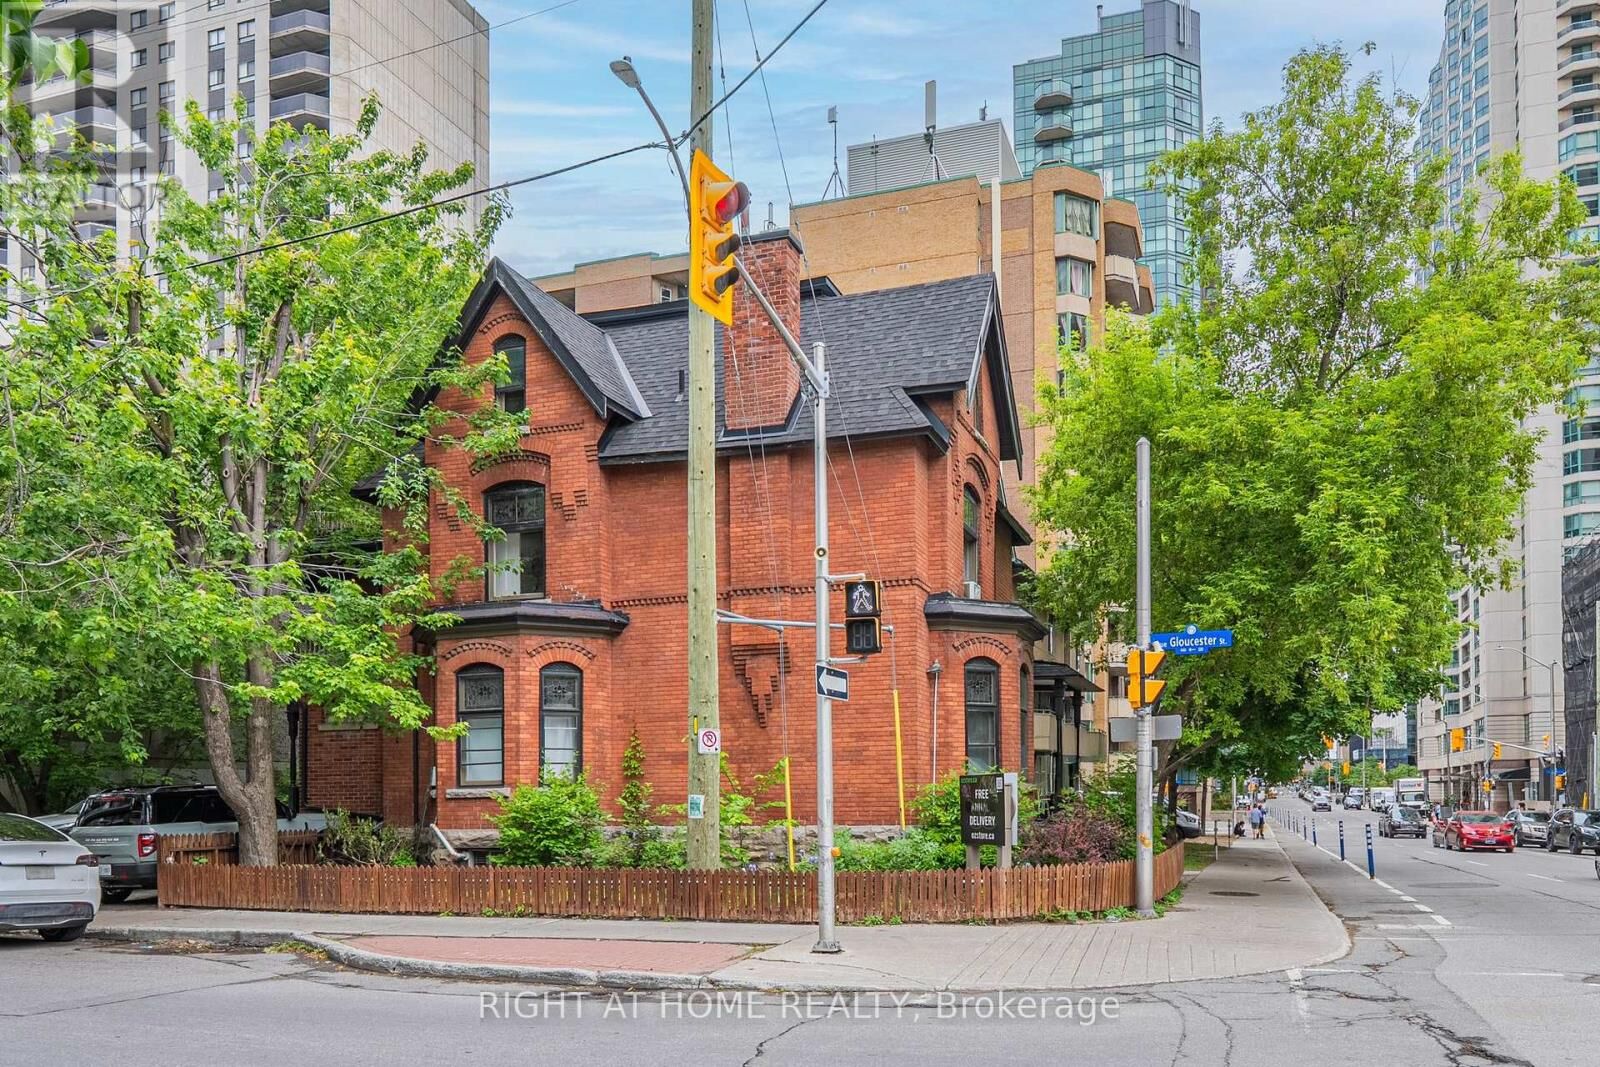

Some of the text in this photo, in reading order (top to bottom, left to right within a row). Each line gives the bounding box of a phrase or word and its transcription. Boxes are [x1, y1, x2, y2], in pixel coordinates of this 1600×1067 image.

[1169, 636, 1217, 647] Gloucester
[975, 789, 989, 800] FREE
[970, 816, 995, 826] DELIVERY
